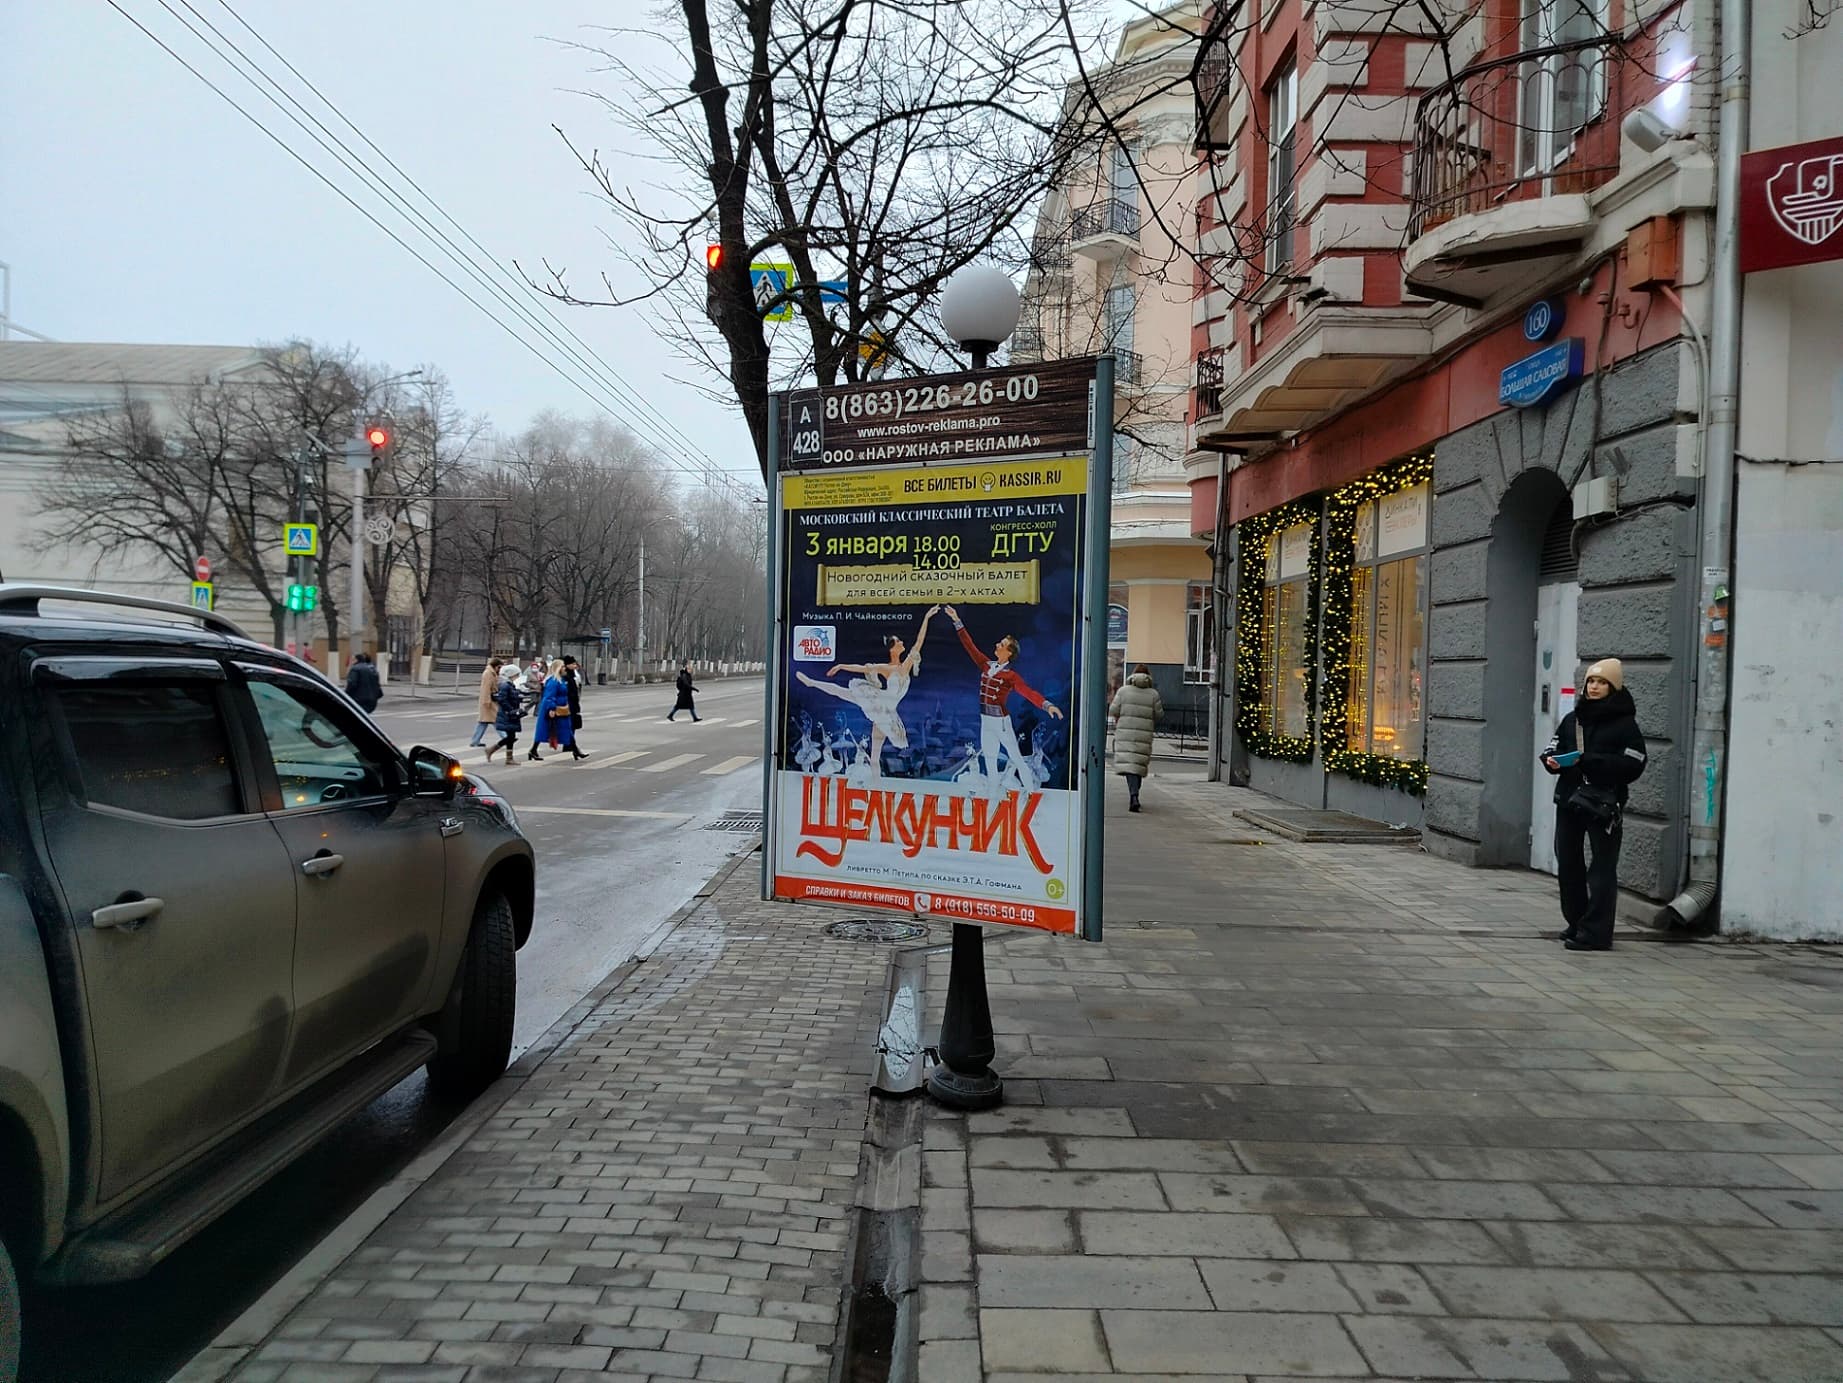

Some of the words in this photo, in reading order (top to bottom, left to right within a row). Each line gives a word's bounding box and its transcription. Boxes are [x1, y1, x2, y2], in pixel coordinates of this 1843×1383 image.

[1529, 307, 1547, 334] 160
[826, 375, 1039, 424] 8(863)226-26-00
[857, 415, 1001, 438] www.rostov-reklama.pro
[793, 430, 820, 454] 428
[823, 450, 854, 464] ООО
[858, 440, 950, 461] «НАРУЖНАЯ
[955, 434, 1041, 453] РЕКЛАМА»
[904, 479, 924, 493] ВСЕ
[927, 476, 977, 491] БИЛЕТЫ
[1000, 470, 1062, 487] KASSIR.RU
[800, 510, 875, 526] МОСКОВСКИЙ
[879, 505, 972, 522] КЛАССИЧЕСКИЙ
[975, 506, 1013, 518] ТЕАТР
[1017, 503, 1065, 516] БАЛЕТА
[990, 520, 1057, 531] КОНГРЕСС-ХОЛЛ
[806, 532, 820, 555] 3
[826, 535, 907, 559] января
[913, 535, 960, 553] 18.00
[991, 531, 1054, 557] ДГТУ
[912, 553, 960, 570] 14.00
[798, 638, 821, 647] АВТО
[804, 647, 832, 656] РАДИО
[796, 775, 1054, 874] ЩЕЛКУНЧИК
[806, 885, 839, 897] СПРАВКИ
[840, 889, 846, 898] И
[848, 890, 872, 900] ЗАКАЗ
[874, 893, 910, 906] БИЛЕТОВ
[1047, 883, 1064, 896] 0+
[935, 897, 942, 909] 8
[945, 898, 973, 915] (918)
[976, 902, 1035, 922] 556-50-09
